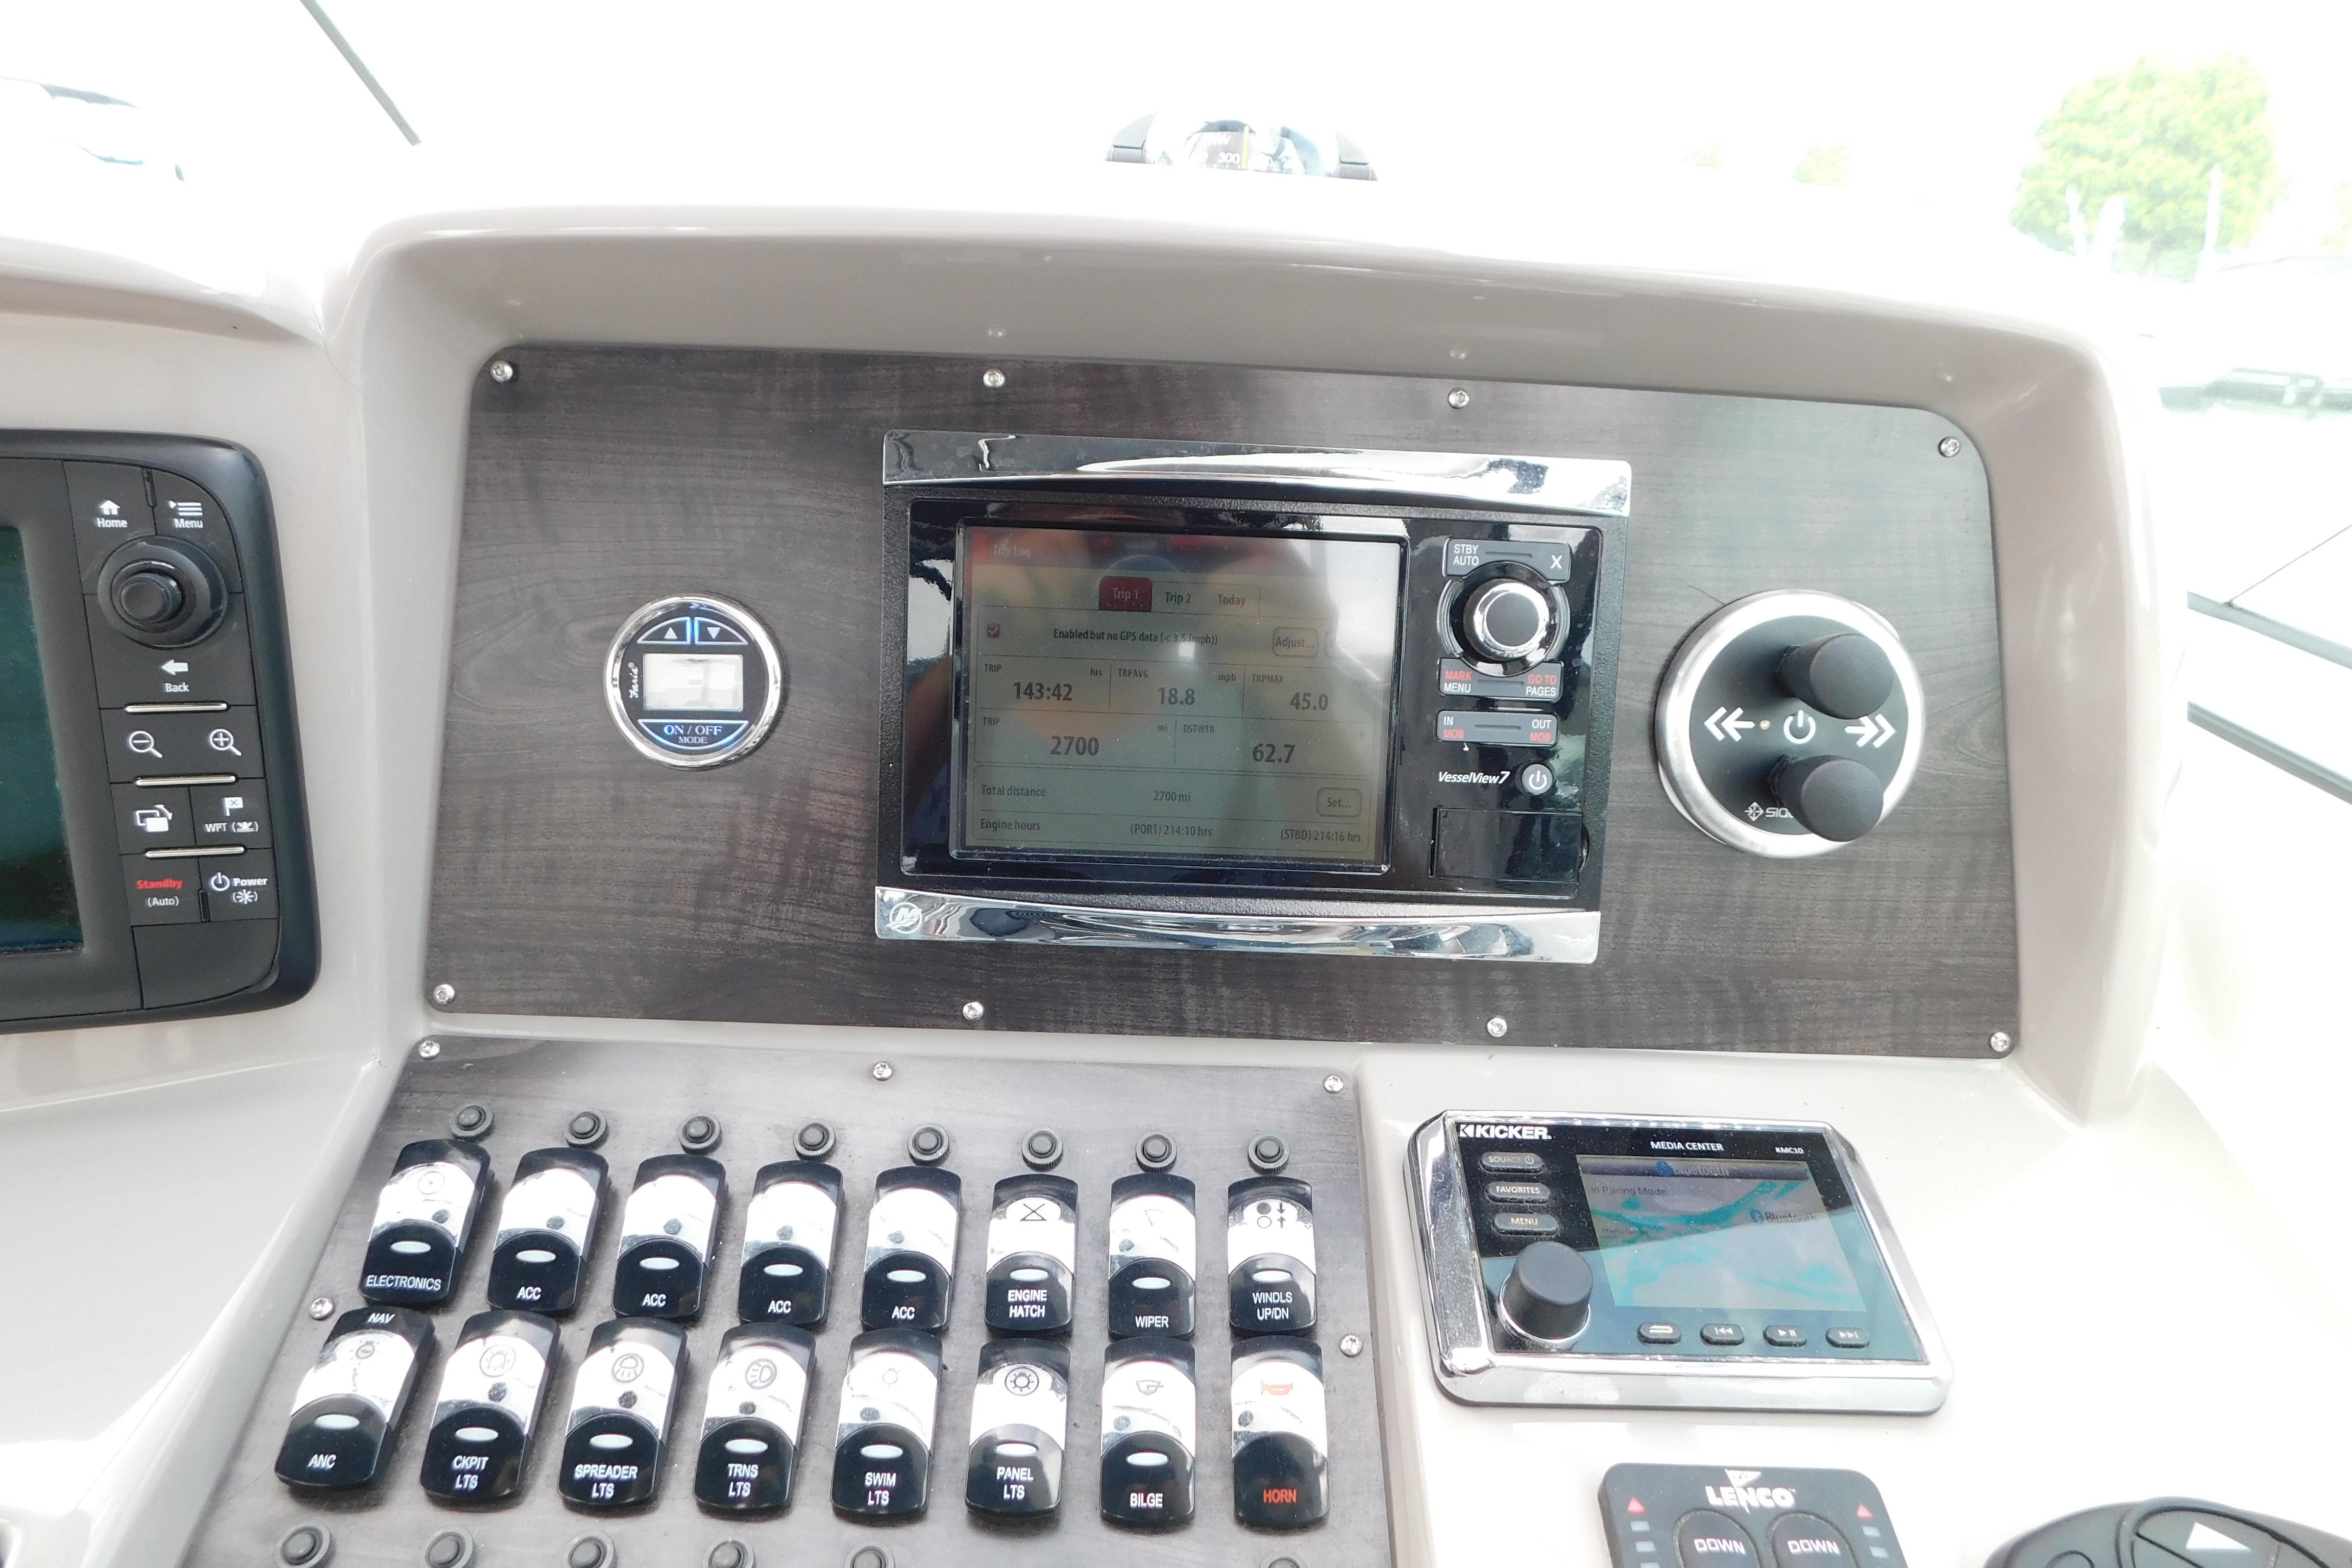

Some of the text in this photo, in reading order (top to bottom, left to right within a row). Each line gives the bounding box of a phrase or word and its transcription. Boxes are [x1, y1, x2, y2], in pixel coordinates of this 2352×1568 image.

[1217, 152, 1240, 164] 300
[97, 518, 128, 528] Home
[175, 518, 203, 528] Menu
[993, 544, 1031, 559] Trip Log
[1454, 544, 1479, 555] STBY
[1453, 555, 1479, 566] AUTO
[1551, 555, 1562, 569] X
[1113, 587, 1139, 600] Trip 1
[1165, 592, 1191, 604] Trip 2
[1218, 594, 1245, 606] Today
[1054, 628, 1088, 640] Enabled
[1090, 630, 1105, 640] but
[1107, 632, 1118, 641] no
[1120, 631, 1136, 641] GPS
[1139, 632, 1158, 642] data
[985, 664, 1001, 673] TRIP
[1090, 668, 1102, 677] hrs
[1118, 669, 1148, 678] TRPAVG
[1218, 673, 1236, 683] mph
[1252, 674, 1284, 683] TRPMAX
[1445, 671, 1472, 680] MARK
[1528, 675, 1557, 684] GO TO
[165, 682, 189, 693] Back
[1014, 681, 1072, 701] 143:42
[1444, 682, 1471, 693] MENU
[1526, 687, 1556, 697] PAGES
[1158, 687, 1195, 705] 18.8
[1290, 692, 1328, 710] 45.0
[983, 717, 1000, 725] TRIP
[1444, 716, 1454, 726] IN
[1532, 719, 1552, 729] OUT
[1158, 724, 1168, 732] mi
[1184, 724, 1215, 733] DSTWTR
[1443, 729, 1465, 739] MOB
[678, 736, 708, 744] MODE
[1530, 732, 1551, 742] MOB
[1050, 736, 1099, 756] 2700
[1253, 743, 1295, 764] 62.7
[981, 785, 1046, 797] Total distance
[1154, 791, 1191, 802] 2700 mi
[205, 822, 227, 832] WPT
[981, 818, 1041, 831] Engine hours
[1131, 823, 1212, 837] (PORT) 214:10 hrs
[1281, 828, 1361, 842] (STBD) 214:16 hrs
[137, 879, 183, 890] Standby
[233, 877, 268, 887] Power
[148, 896, 179, 907] (Auto)
[1650, 1140, 1725, 1152] MEDIA CENTER
[1496, 1185, 1540, 1194] FAVORITES
[1602, 1186, 1636, 1195] Pairing
[1638, 1187, 1668, 1195] Mode
[1511, 1217, 1538, 1226] MENU
[365, 1275, 442, 1291] ELECTRONICS
[517, 1286, 542, 1300] ACC
[1008, 1289, 1047, 1302] ENGINE
[1252, 1292, 1293, 1304] WINDLS
[642, 1293, 667, 1307] ACC
[768, 1300, 792, 1314] ACC
[1009, 1305, 1045, 1318] HATCH
[368, 1313, 395, 1325] NAV
[892, 1307, 916, 1320] ACC
[1257, 1307, 1289, 1321] UP/DN
[1135, 1315, 1169, 1329] WIPER
[308, 1454, 337, 1469] ANC
[452, 1456, 489, 1471] CKPIT
[574, 1463, 638, 1480] SPREADER
[727, 1463, 759, 1478] TRNS
[996, 1466, 1034, 1481] PANEL
[455, 1474, 479, 1490] LTS
[865, 1472, 896, 1487] SWIM
[592, 1482, 615, 1498] LTS
[728, 1481, 751, 1498] LTS
[1003, 1484, 1025, 1501] LTS
[1263, 1488, 1297, 1503] HORN
[868, 1490, 890, 1506] LTS
[1130, 1492, 1163, 1508] BILGE
[1705, 1486, 1794, 1513] LENCO
[1694, 1539, 1746, 1555] DOWN
[1787, 1539, 1841, 1555] DOWN
